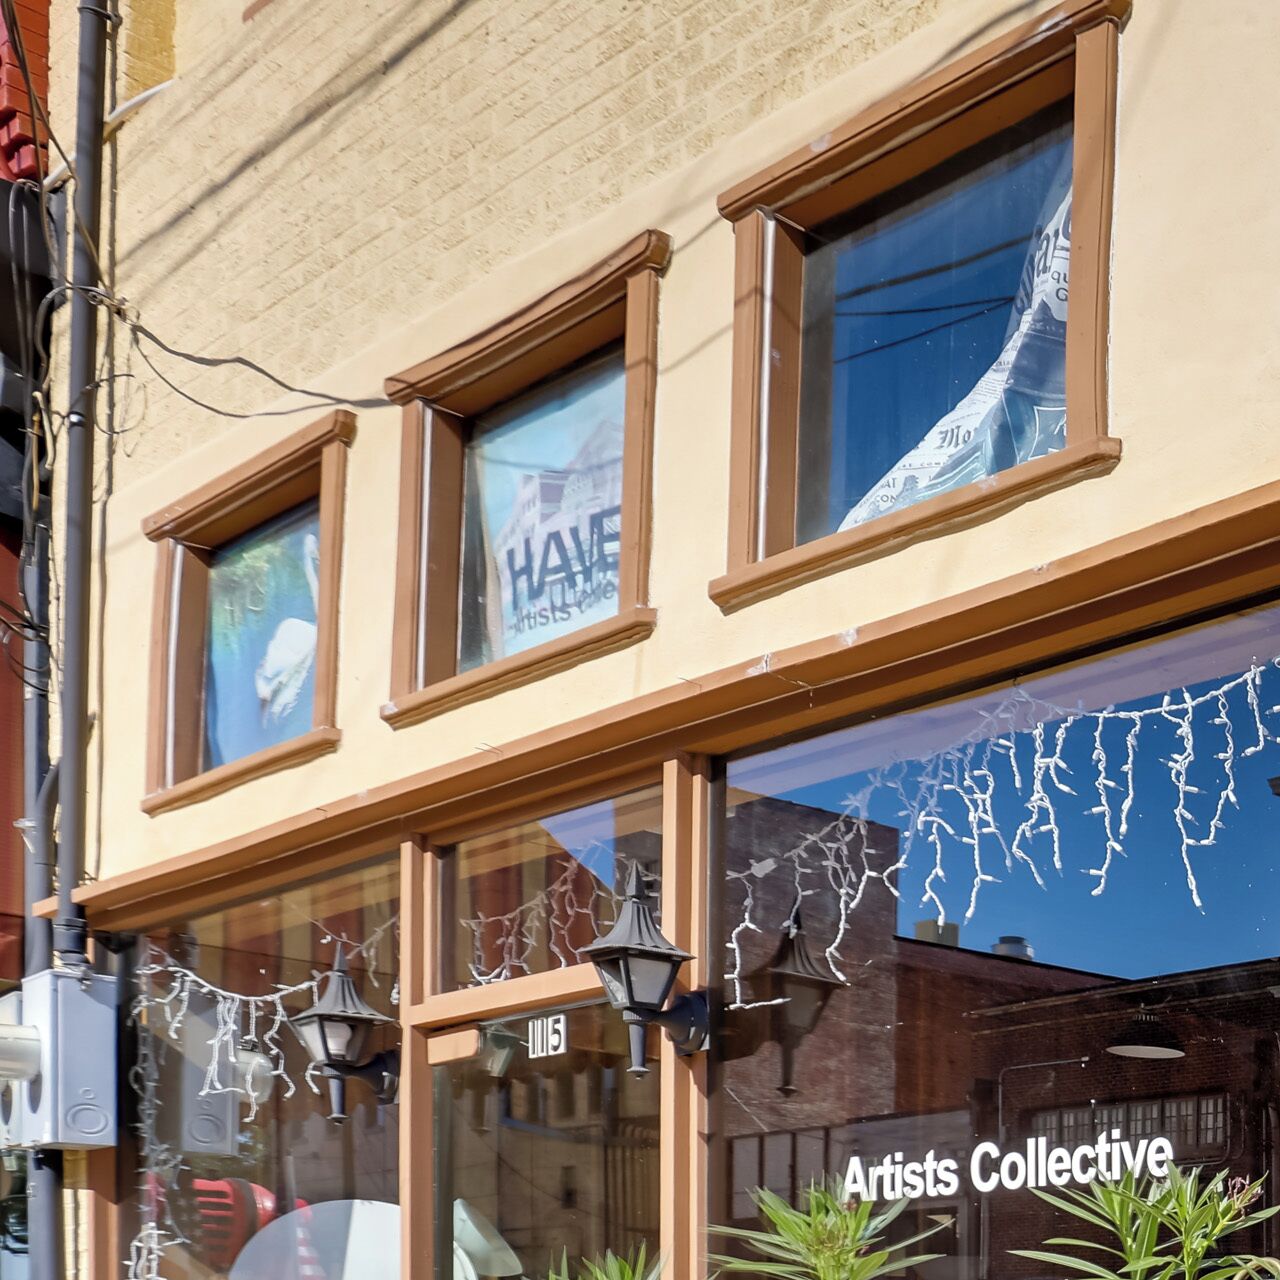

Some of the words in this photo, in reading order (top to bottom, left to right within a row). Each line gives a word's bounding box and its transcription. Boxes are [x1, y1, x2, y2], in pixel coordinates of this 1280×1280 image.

[531, 1017, 562, 1053] 115
[844, 1149, 959, 1202] Artists
[970, 1128, 1174, 1193] Collective
